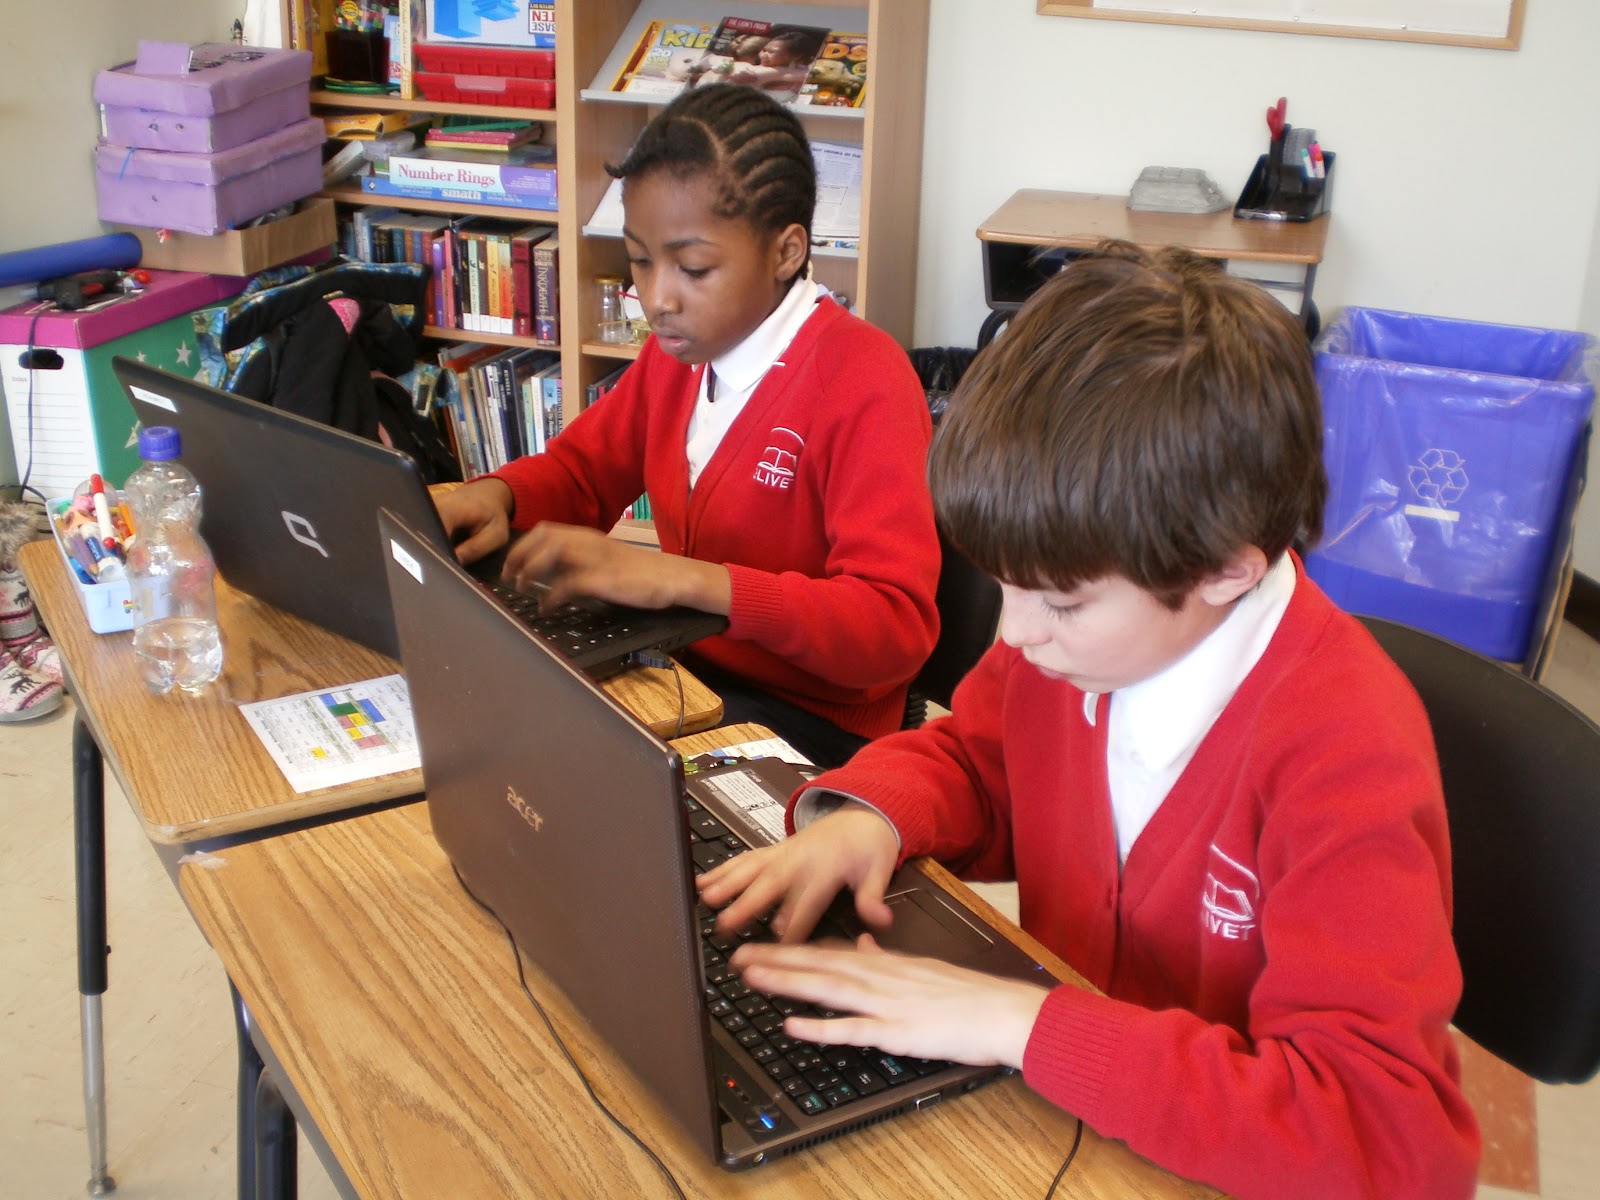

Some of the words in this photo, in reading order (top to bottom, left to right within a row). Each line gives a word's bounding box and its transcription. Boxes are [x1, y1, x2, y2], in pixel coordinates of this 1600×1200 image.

[532, 11, 556, 22] TEN
[398, 163, 454, 182] Number
[458, 169, 496, 188] Rings
[753, 469, 794, 489] LIVE
[507, 785, 543, 832] acer
